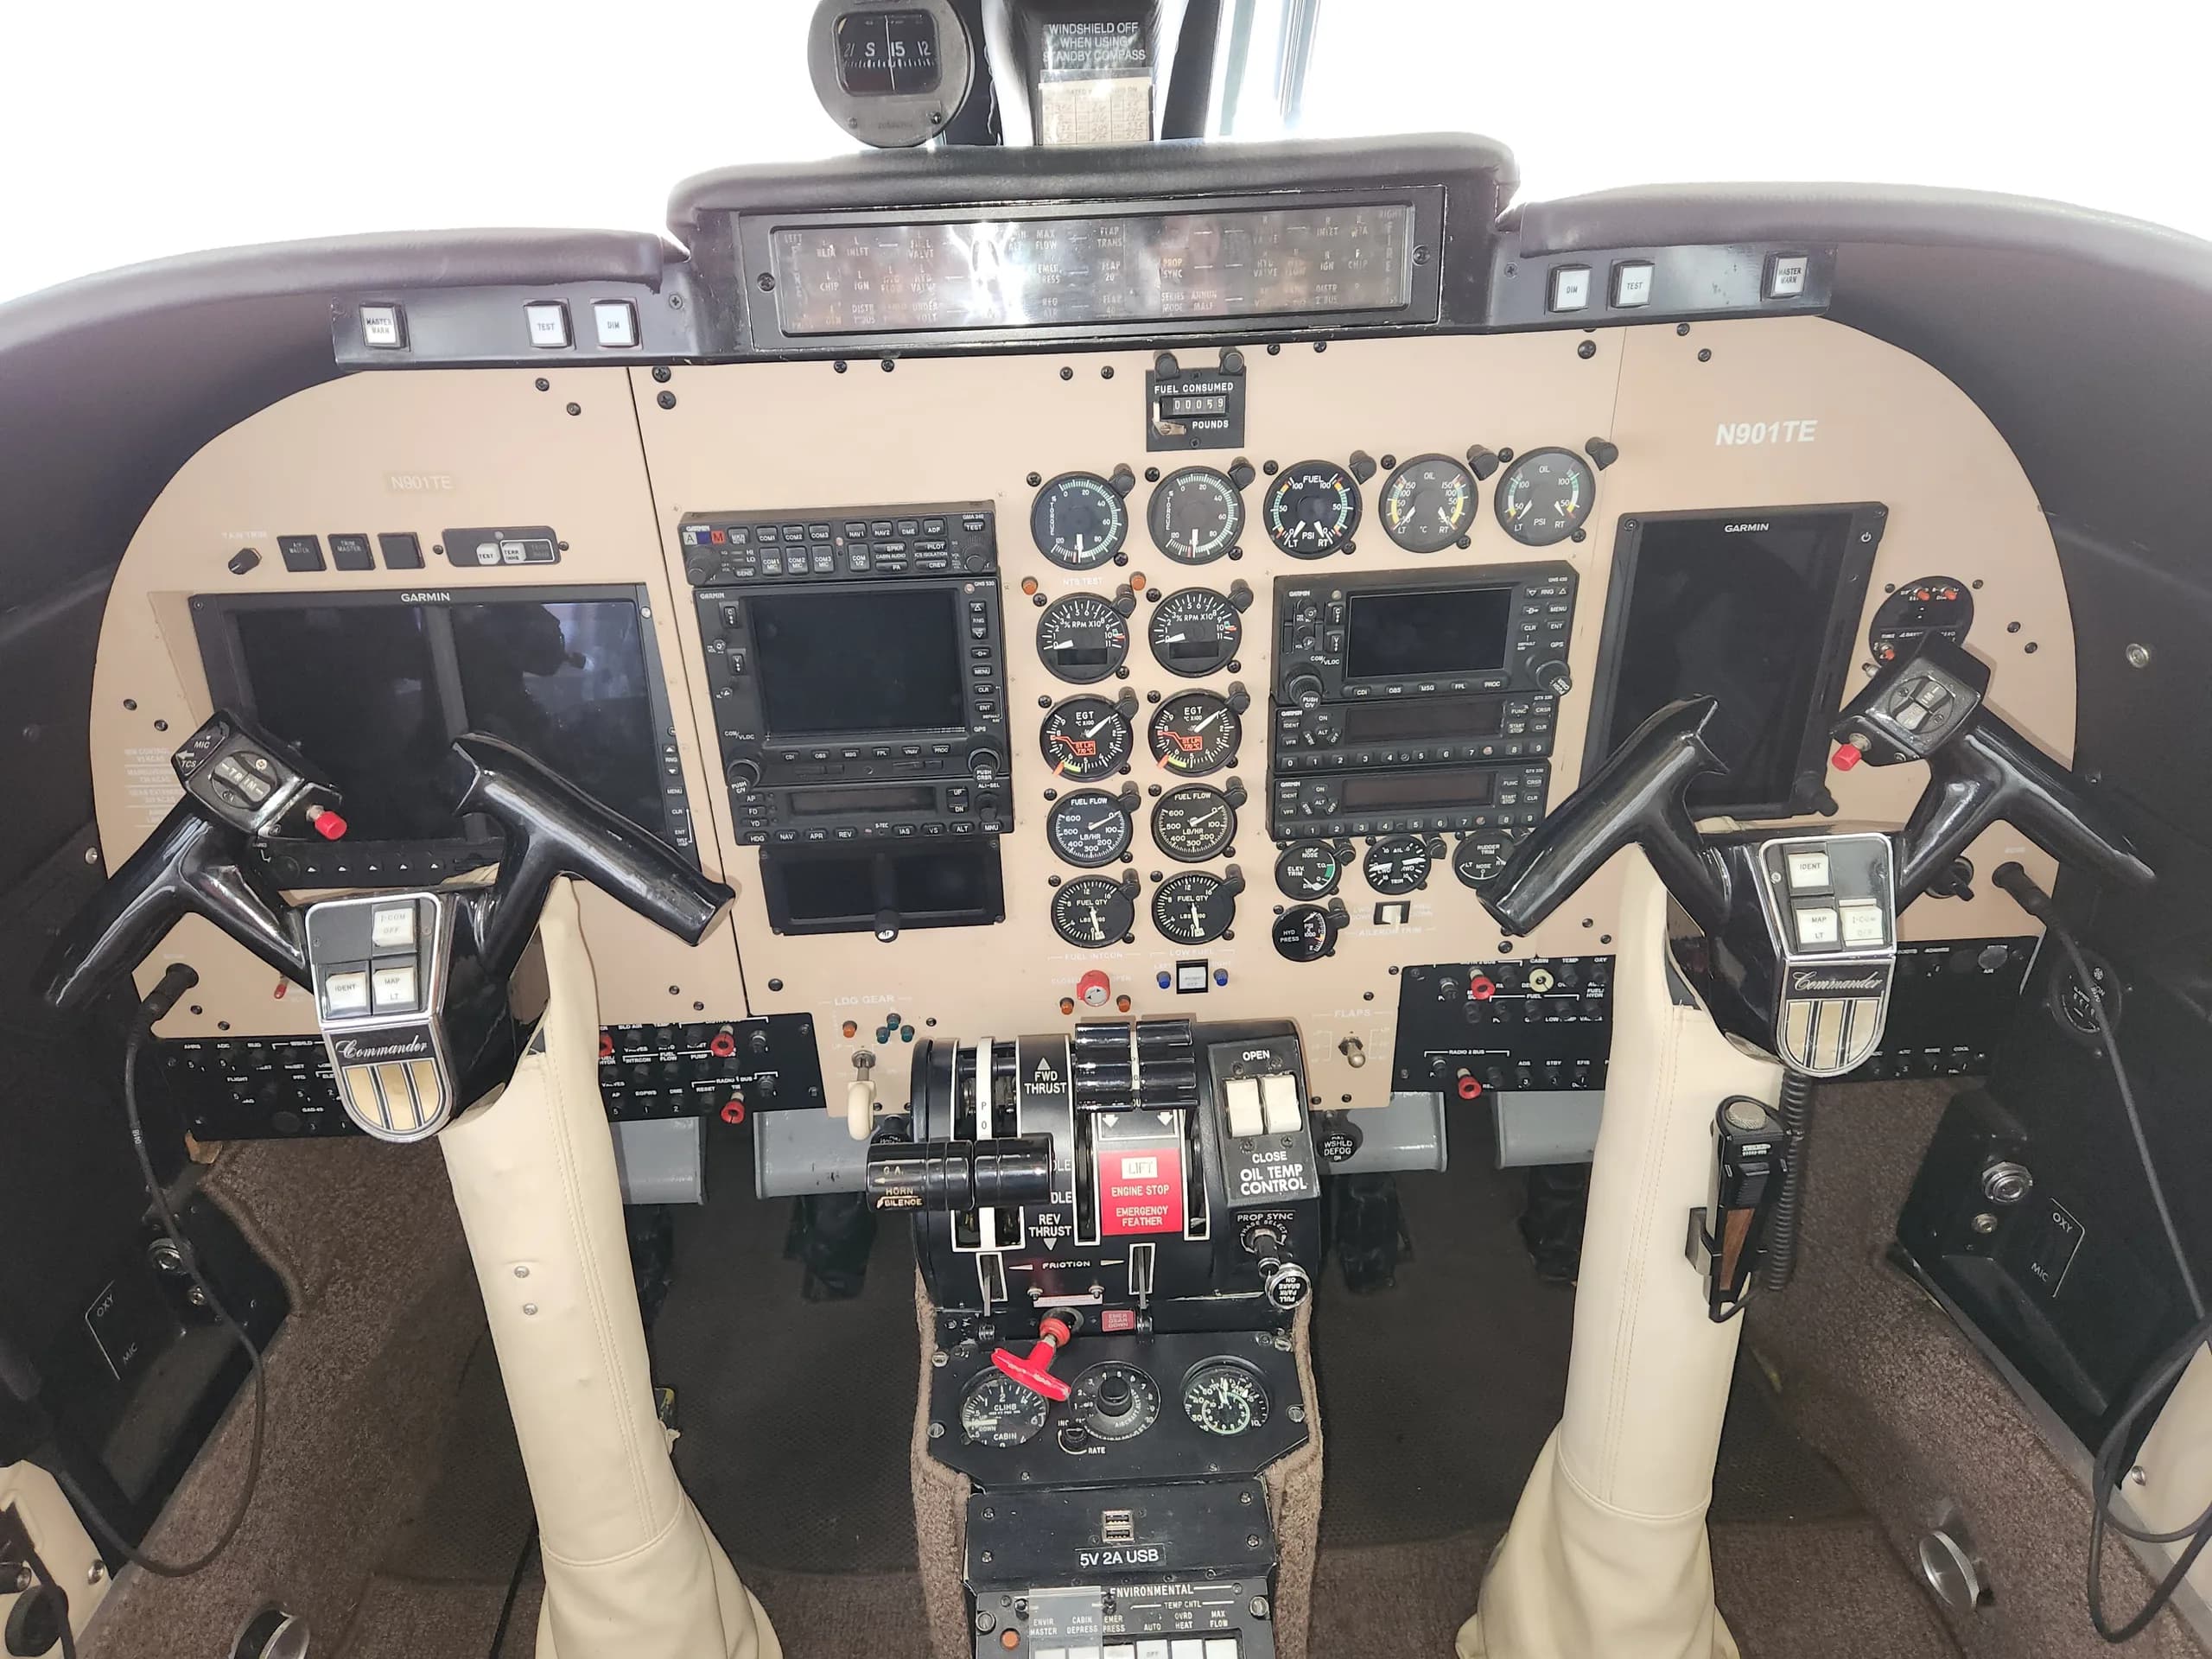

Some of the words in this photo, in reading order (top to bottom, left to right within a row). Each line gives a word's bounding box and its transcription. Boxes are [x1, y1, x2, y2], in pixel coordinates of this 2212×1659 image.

[1049, 22, 1114, 35] WINDSHIELD
[1116, 22, 1139, 34] OFF
[1060, 36, 1092, 48] WHEN
[1095, 35, 1128, 48] USING
[865, 42, 875, 57] S
[891, 42, 906, 57] 15
[918, 41, 931, 56] 12
[1093, 49, 1146, 61] COMPASS
[1036, 230, 1055, 238] MAX
[1163, 257, 1182, 266] PROP
[1163, 270, 1183, 278] SYNC
[1778, 267, 1802, 276] MASTER
[855, 281, 869, 291] IGN
[1627, 282, 1642, 290] TEST
[537, 322, 556, 332] TEST
[607, 321, 620, 329] DIM
[1154, 385, 1179, 394] FUEL
[1183, 383, 1234, 392] CONSUMED
[1192, 420, 1229, 429] POUNDS
[1715, 420, 1818, 446] N901TE
[391, 475, 453, 491] N901TE
[1725, 523, 1770, 534] GARMIN
[1302, 531, 1315, 540] PSI
[400, 592, 451, 602] GARMIN
[1076, 711, 1095, 720] EGT
[194, 740, 210, 749] MIC
[181, 760, 196, 768] TCS
[1792, 971, 1882, 991] Commander
[835, 995, 859, 1006] LDG
[862, 995, 895, 1004] GEAR
[335, 1035, 428, 1058] Commander
[1243, 1050, 1270, 1061] OPEN
[1035, 1071, 1058, 1081] FWD
[1025, 1083, 1066, 1094] THRUST
[1324, 1140, 1353, 1148] WSHLD
[1324, 1147, 1351, 1156] DEFOG
[1252, 1152, 1287, 1163] CLOSE
[1128, 1160, 1153, 1174] LIFT
[1240, 1168, 1262, 1181] OIL
[1268, 1164, 1303, 1178] TEMP
[886, 1187, 913, 1196] HORN
[1111, 1186, 1146, 1196] ENGINE
[1148, 1185, 1170, 1195] STOP
[1240, 1177, 1307, 1196] CONTROL
[1116, 1205, 1168, 1217] EMERGENCY
[1039, 1215, 1061, 1224] REV
[1122, 1215, 1163, 1226] FEATHER
[1237, 1214, 1263, 1223] PROP
[1266, 1212, 1294, 1221] SYNC
[2052, 1211, 2073, 1234] OXY
[1028, 1225, 1071, 1237] THRUST
[2031, 1262, 2049, 1282] MIC
[97, 1294, 115, 1317] OXY
[123, 1343, 137, 1364] MIC
[993, 1432, 1017, 1440] CABIN
[1088, 1446, 1105, 1455] RATE
[1079, 1553, 1100, 1567] 5V
[1103, 1551, 1123, 1565] 2A
[1126, 1549, 1159, 1563] USB
[1109, 1585, 1194, 1597] ENVIRONMENTAL
[1175, 1611, 1192, 1620] OVRD
[1033, 1618, 1053, 1626] ENVIR
[1210, 1618, 1228, 1627] FLOW
[1066, 1625, 1098, 1634] DEPRESS
